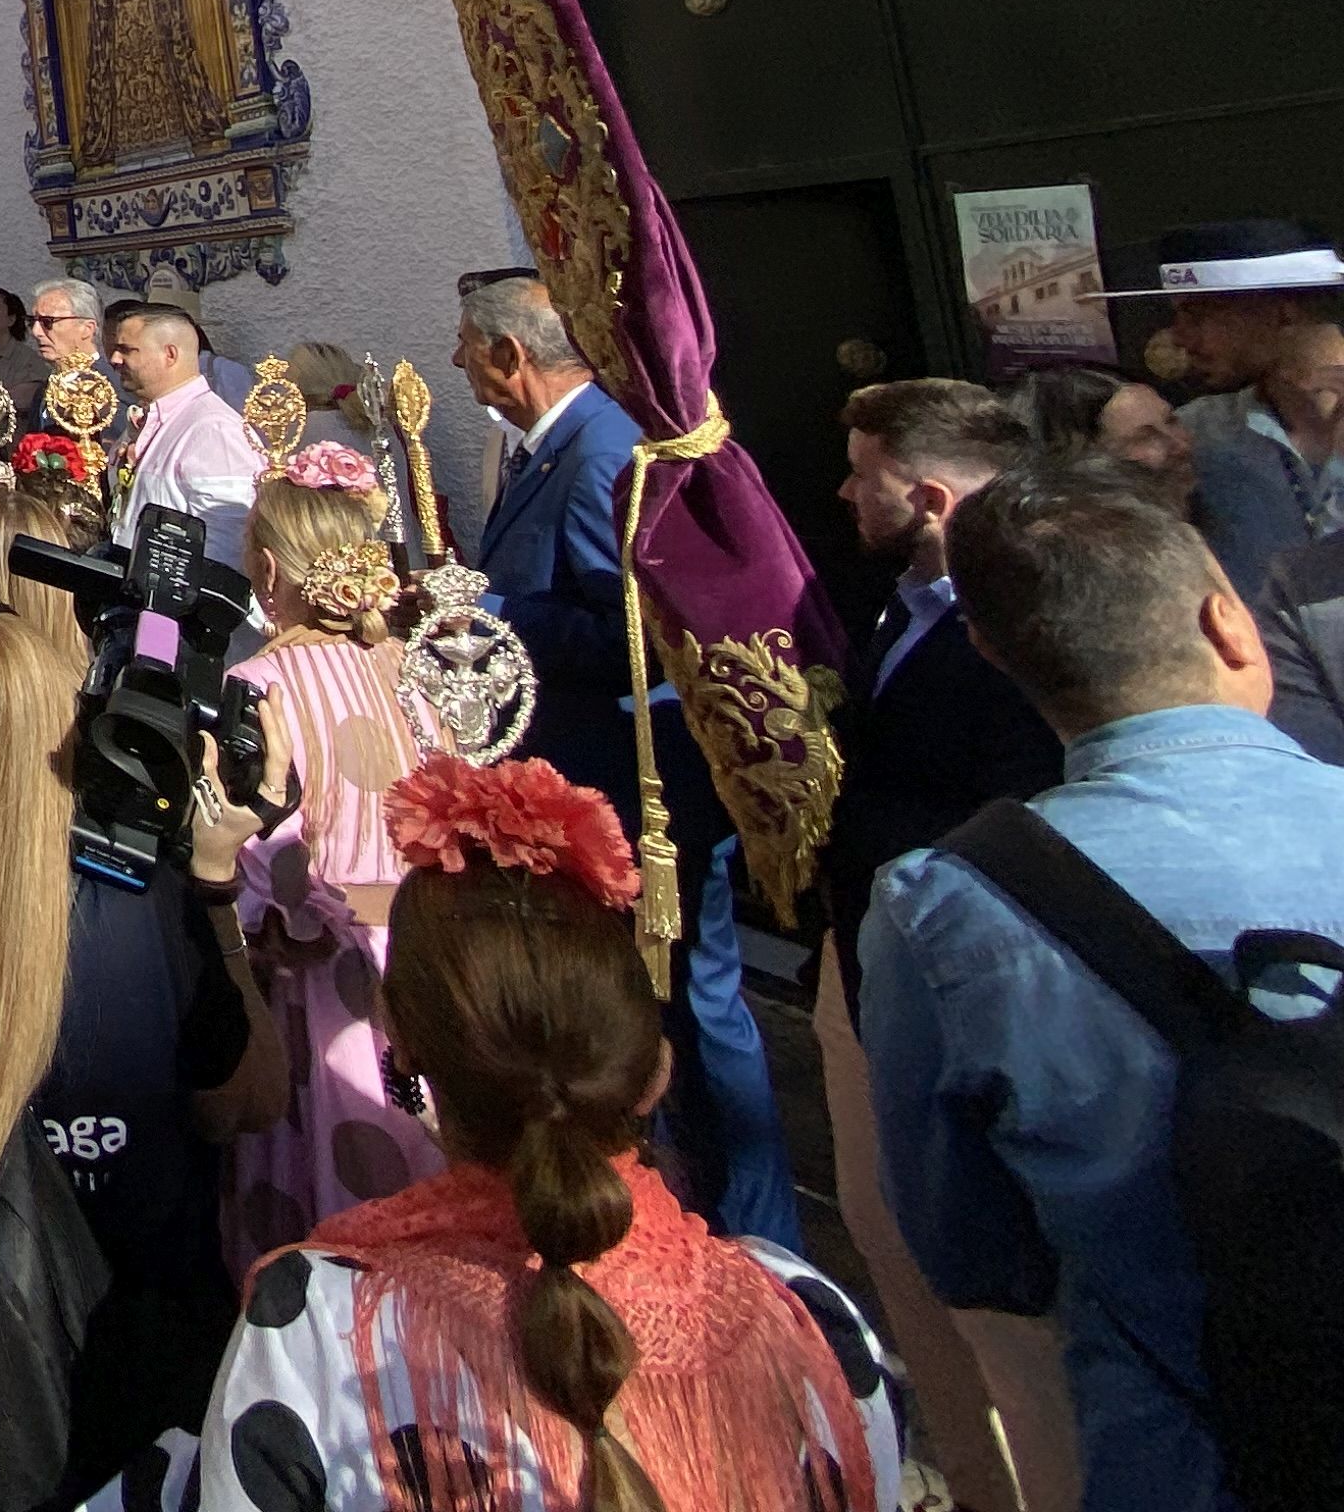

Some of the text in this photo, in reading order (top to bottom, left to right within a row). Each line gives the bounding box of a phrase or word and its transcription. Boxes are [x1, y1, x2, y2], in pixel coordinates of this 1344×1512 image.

[979, 223, 1080, 245] SOLIDARIA
[1162, 268, 1198, 285] GA
[42, 1115, 128, 1161] aga
